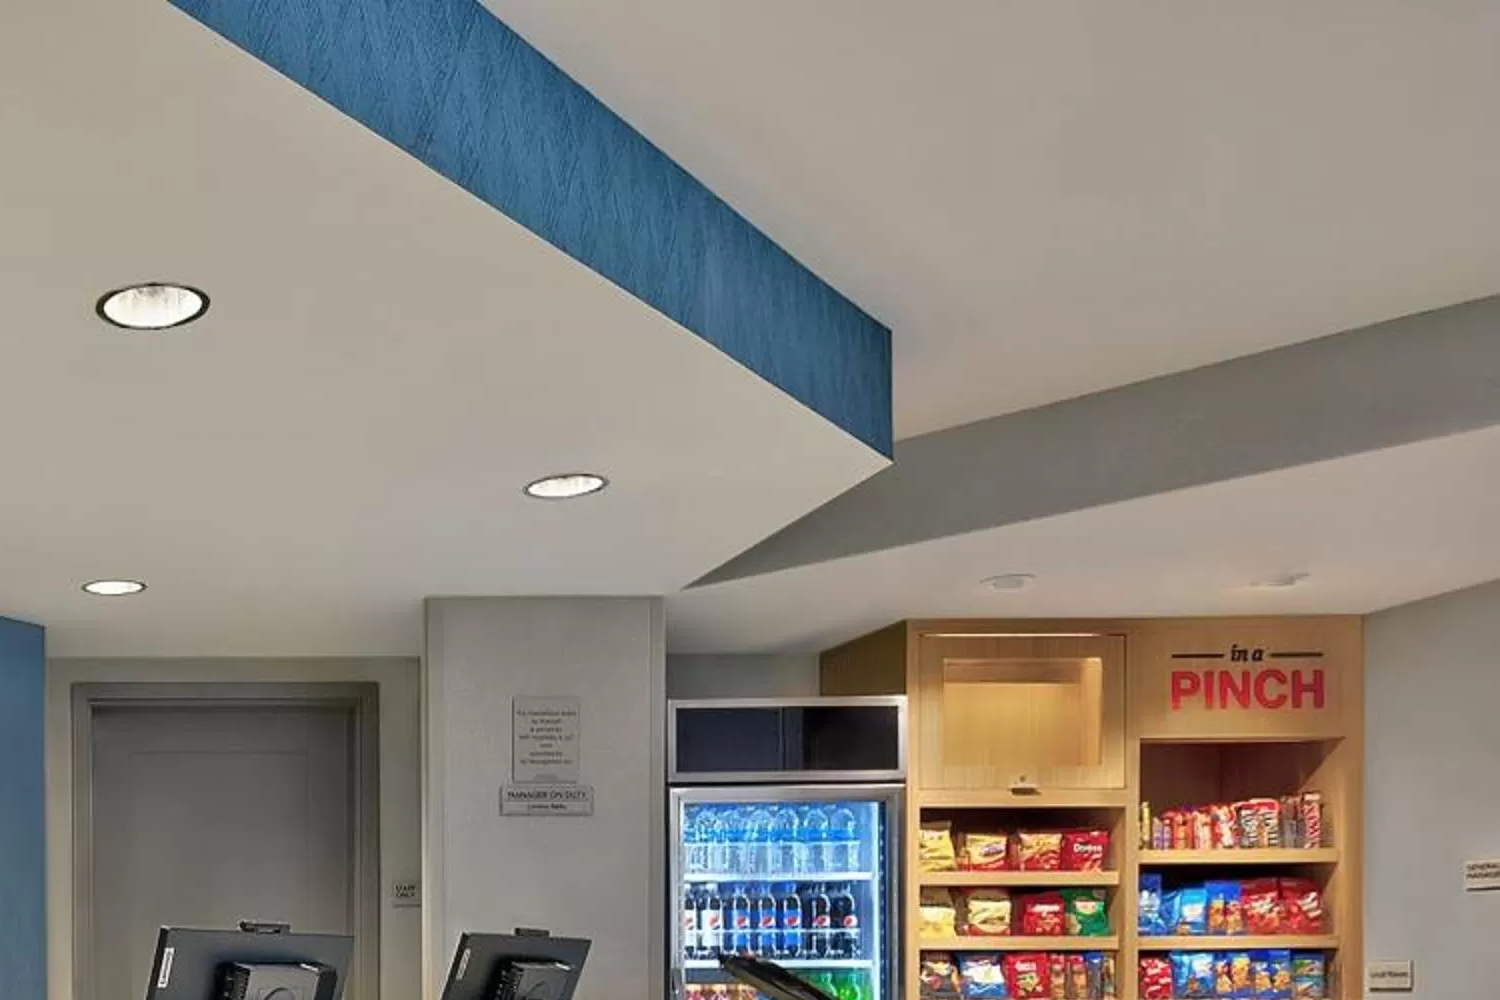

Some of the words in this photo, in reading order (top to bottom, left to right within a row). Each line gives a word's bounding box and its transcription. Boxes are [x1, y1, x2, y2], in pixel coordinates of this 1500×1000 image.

[1231, 644, 1248, 662] in
[1251, 649, 1264, 662] a
[1171, 669, 1325, 711] PINCH
